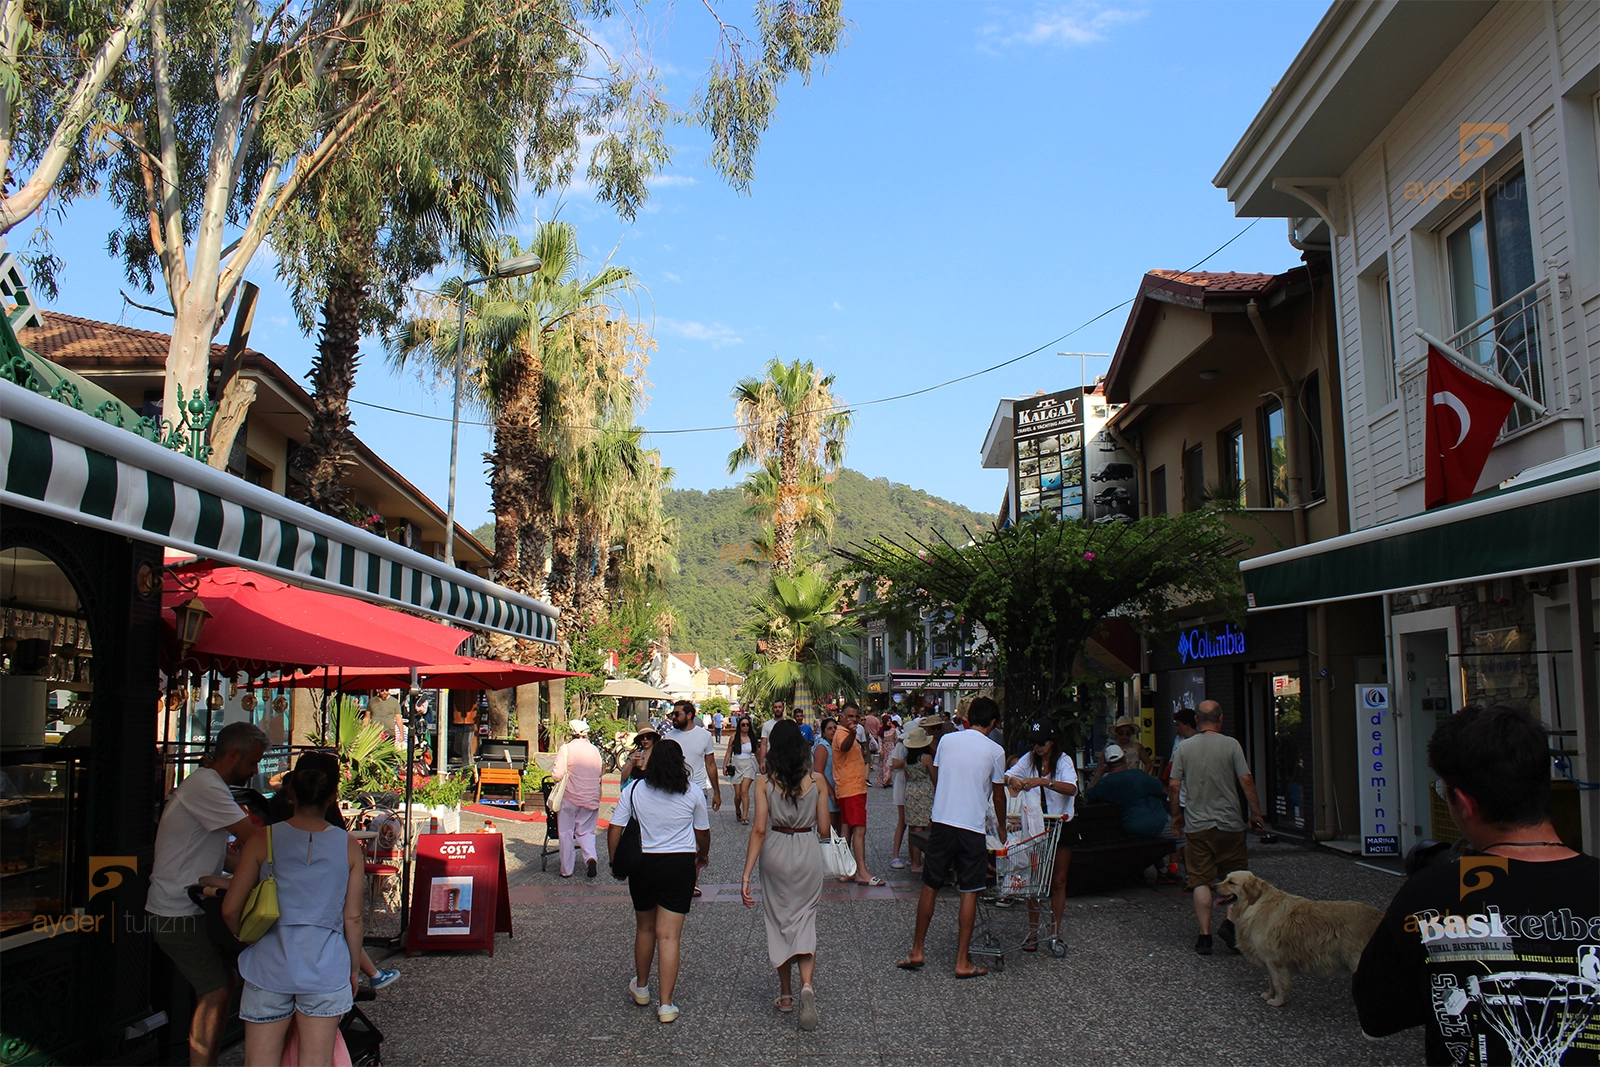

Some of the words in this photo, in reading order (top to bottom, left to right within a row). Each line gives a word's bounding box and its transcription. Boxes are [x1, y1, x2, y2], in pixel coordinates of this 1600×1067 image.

[1018, 398, 1077, 426] KALGAY
[1017, 426, 1033, 434] TRAVEL
[1058, 417, 1077, 425] AGENCY
[1189, 623, 1246, 660] Columbia
[1370, 711, 1387, 834] dedeminn
[1366, 837, 1396, 845] MARINA
[439, 845, 476, 855] COSTA
[1452, 942, 1500, 952] BASKETBALL
[1521, 954, 1553, 964] BASKETBALL
[1554, 956, 1574, 964] LEAGUE
